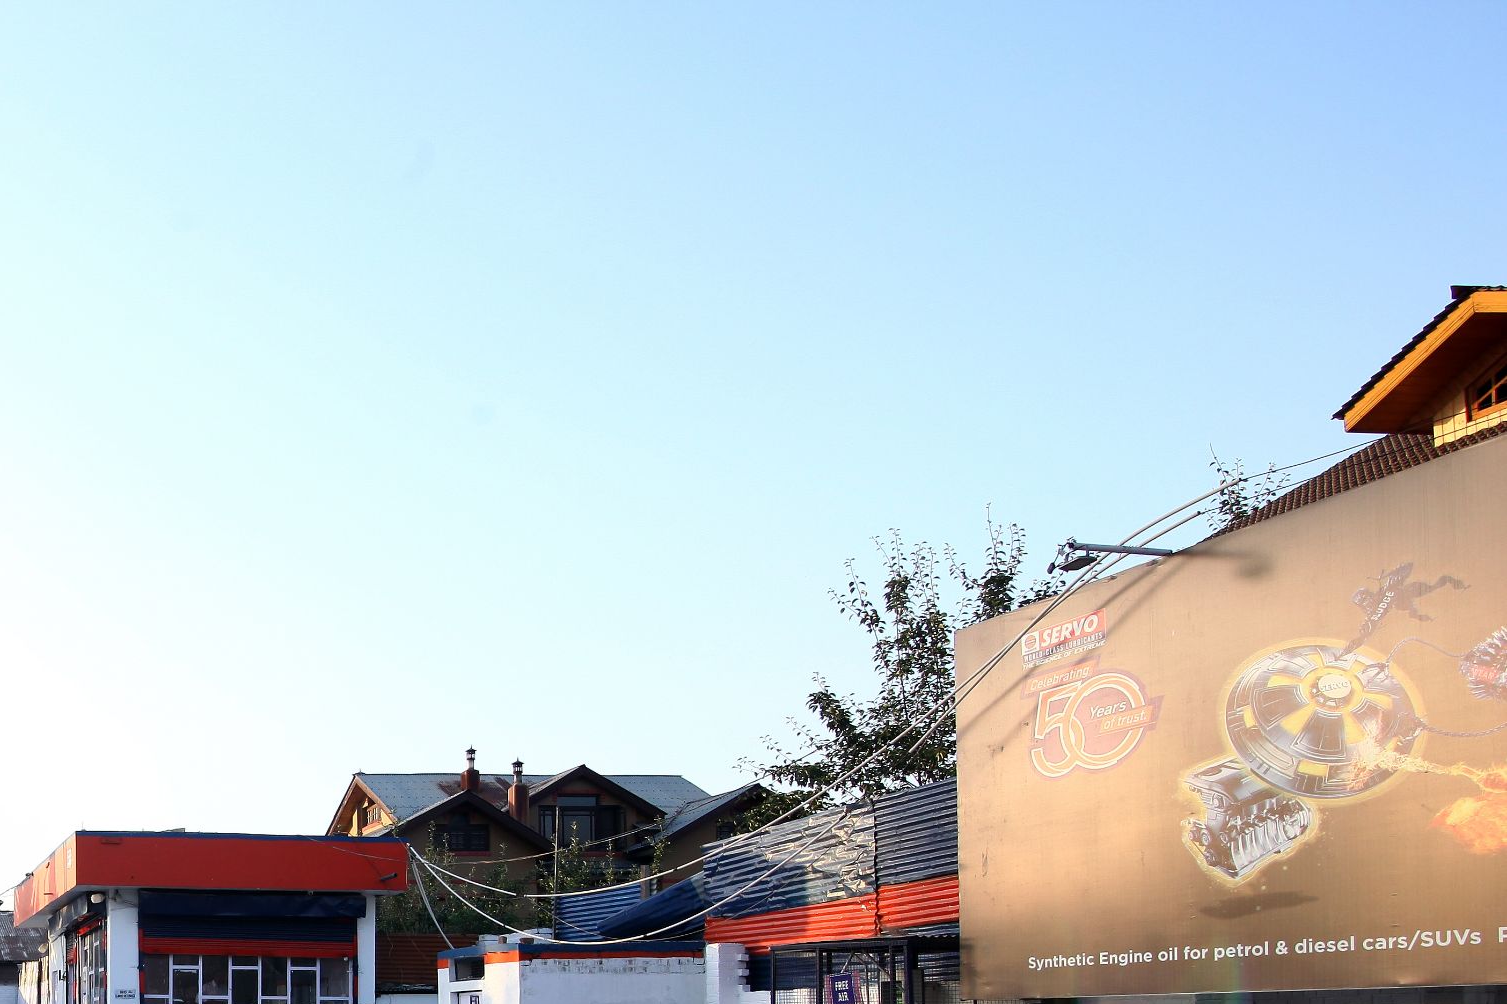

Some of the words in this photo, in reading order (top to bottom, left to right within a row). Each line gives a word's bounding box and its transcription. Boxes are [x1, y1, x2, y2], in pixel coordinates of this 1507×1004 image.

[1041, 614, 1098, 647] SERVO
[1030, 666, 1090, 691] Celebrating
[1090, 701, 1127, 719] Years
[1031, 672, 1146, 778] 50
[1103, 717, 1115, 730] of
[1028, 953, 1095, 970] Synthetic
[1099, 950, 1153, 967] Engine
[1157, 947, 1178, 962] oil
[1183, 946, 1208, 960] for
[1214, 941, 1269, 961] petrol
[1275, 940, 1289, 955] &
[1294, 935, 1355, 954] diesel
[1362, 928, 1482, 951] cars/SUVs
[835, 980, 849, 991] FREE
[838, 991, 849, 1002] AIR
